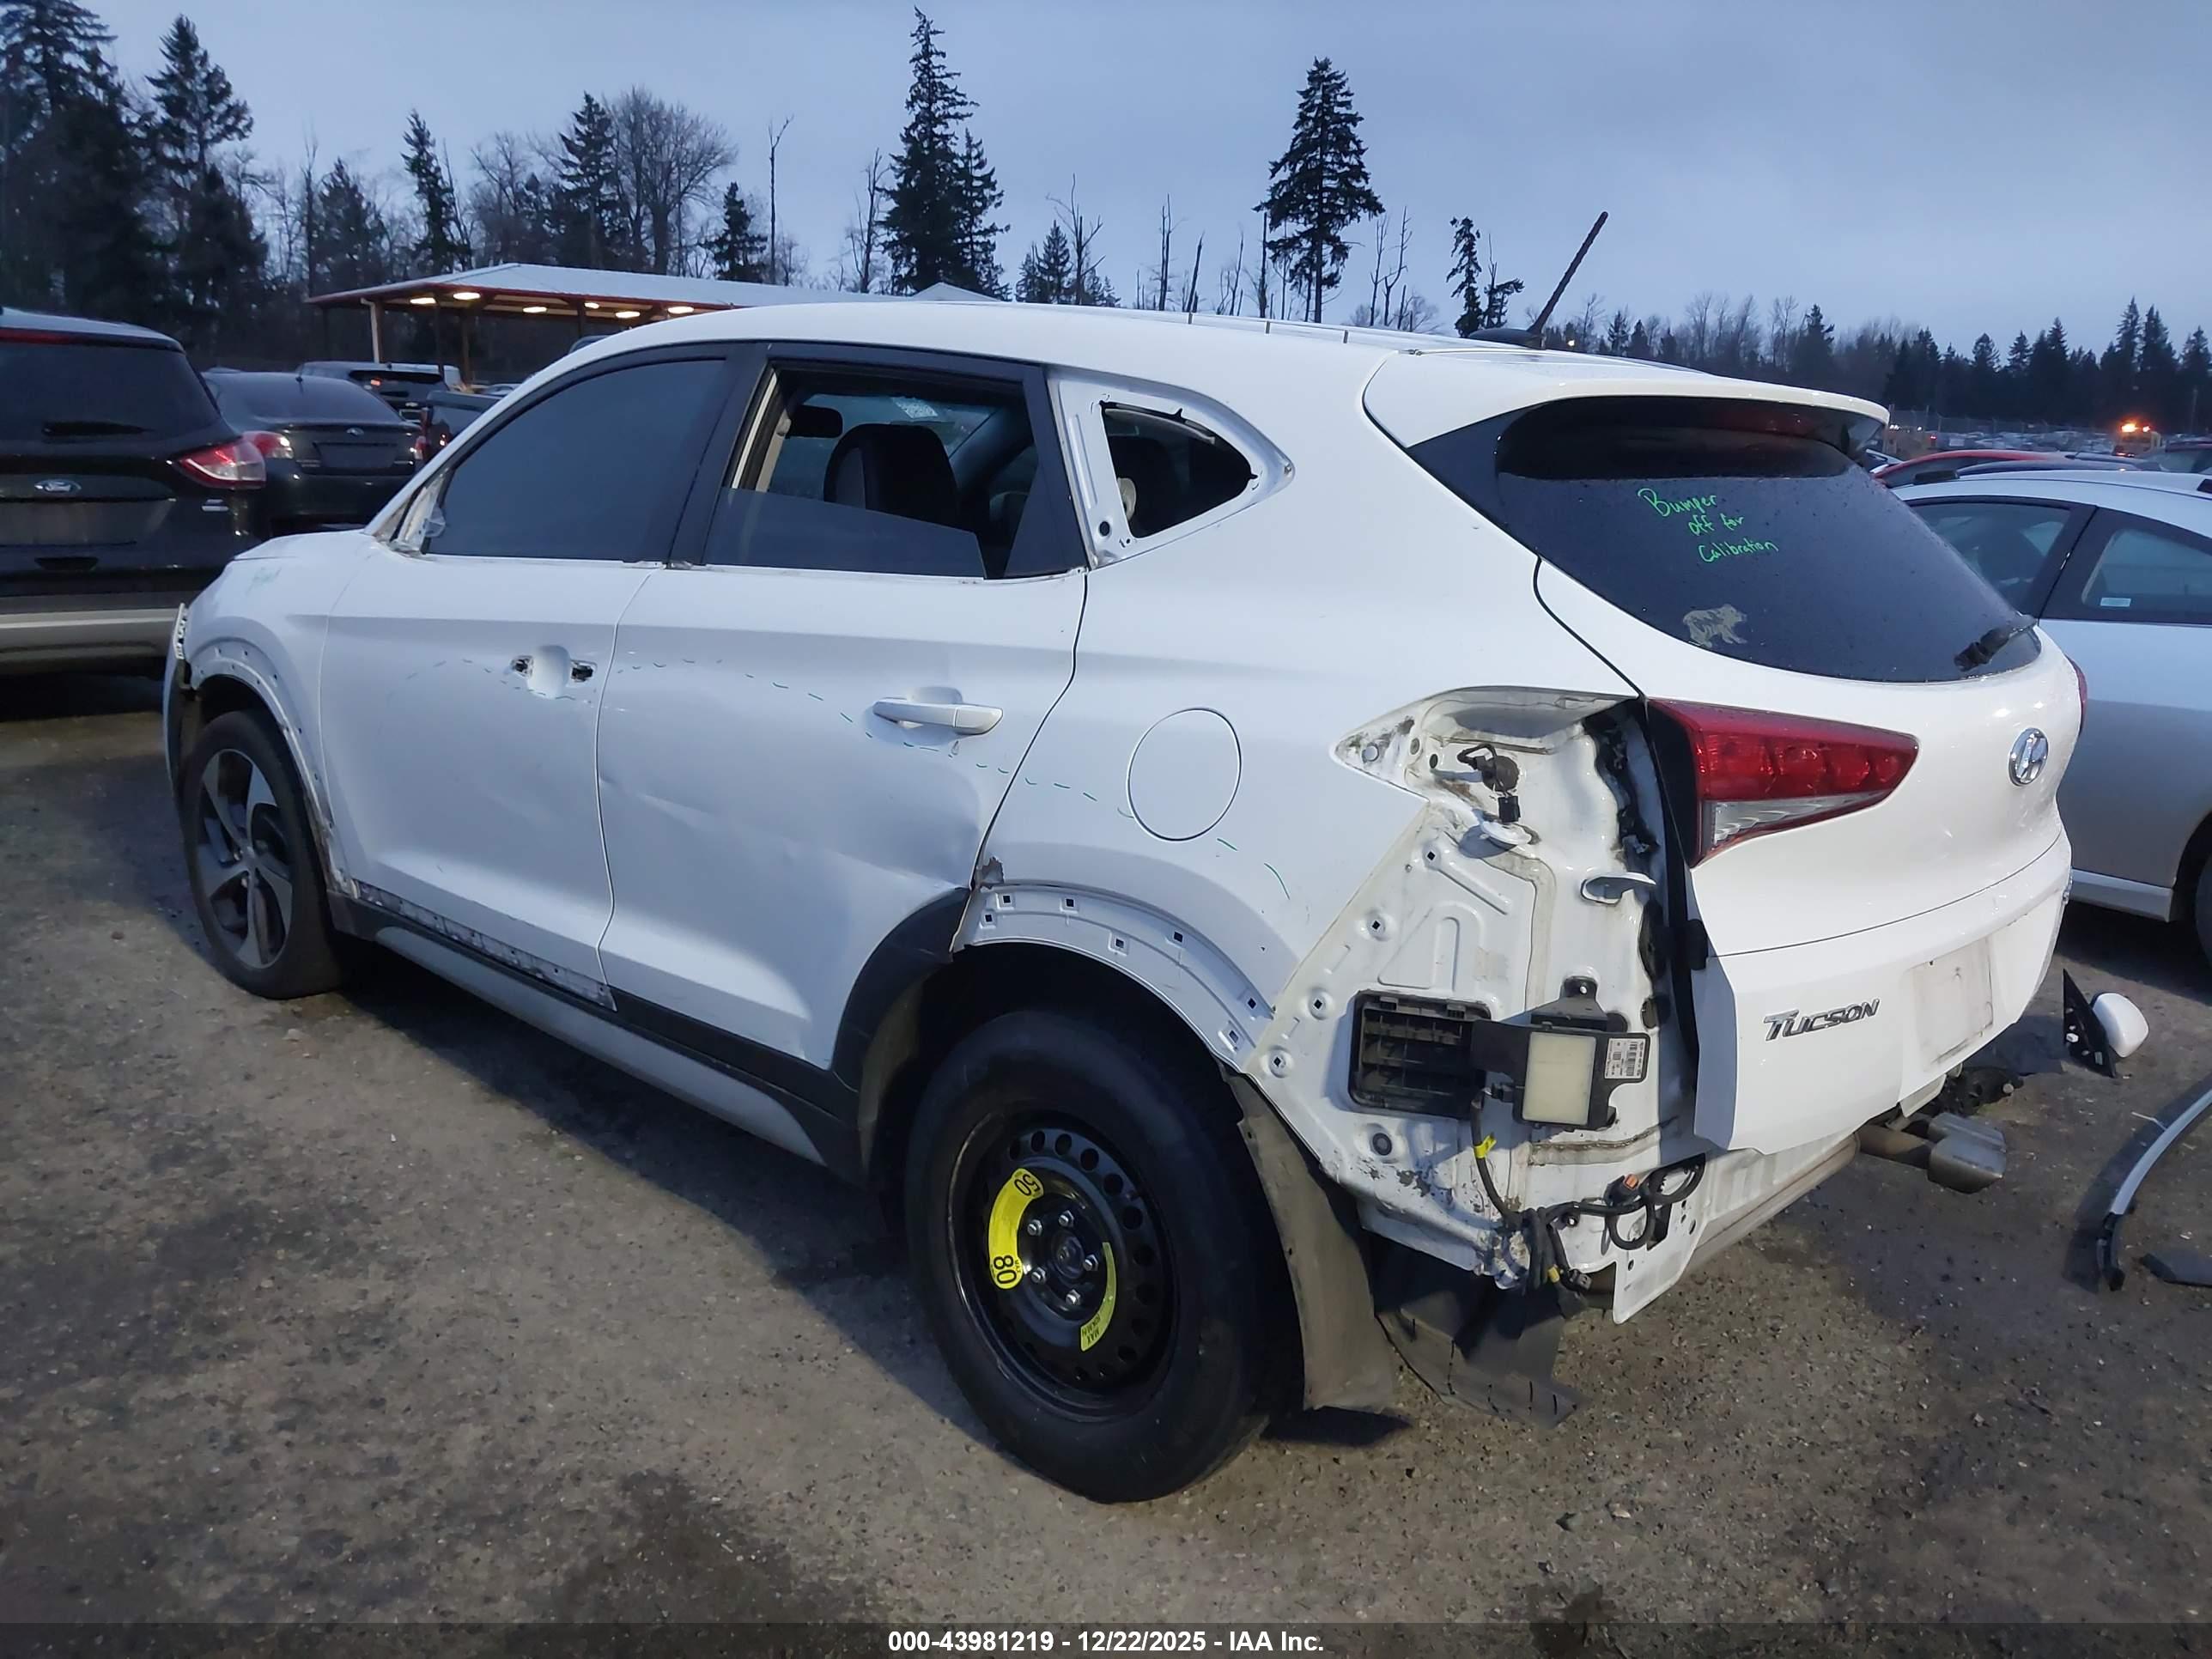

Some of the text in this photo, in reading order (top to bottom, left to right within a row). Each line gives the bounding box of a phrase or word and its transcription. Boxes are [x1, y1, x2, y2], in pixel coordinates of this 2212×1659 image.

[1638, 488, 1717, 517] Bumper
[1720, 513, 1745, 530] for
[1698, 538, 1779, 562] Calibration
[1014, 1174, 1040, 1196] 50
[994, 1255, 1017, 1284] 80
